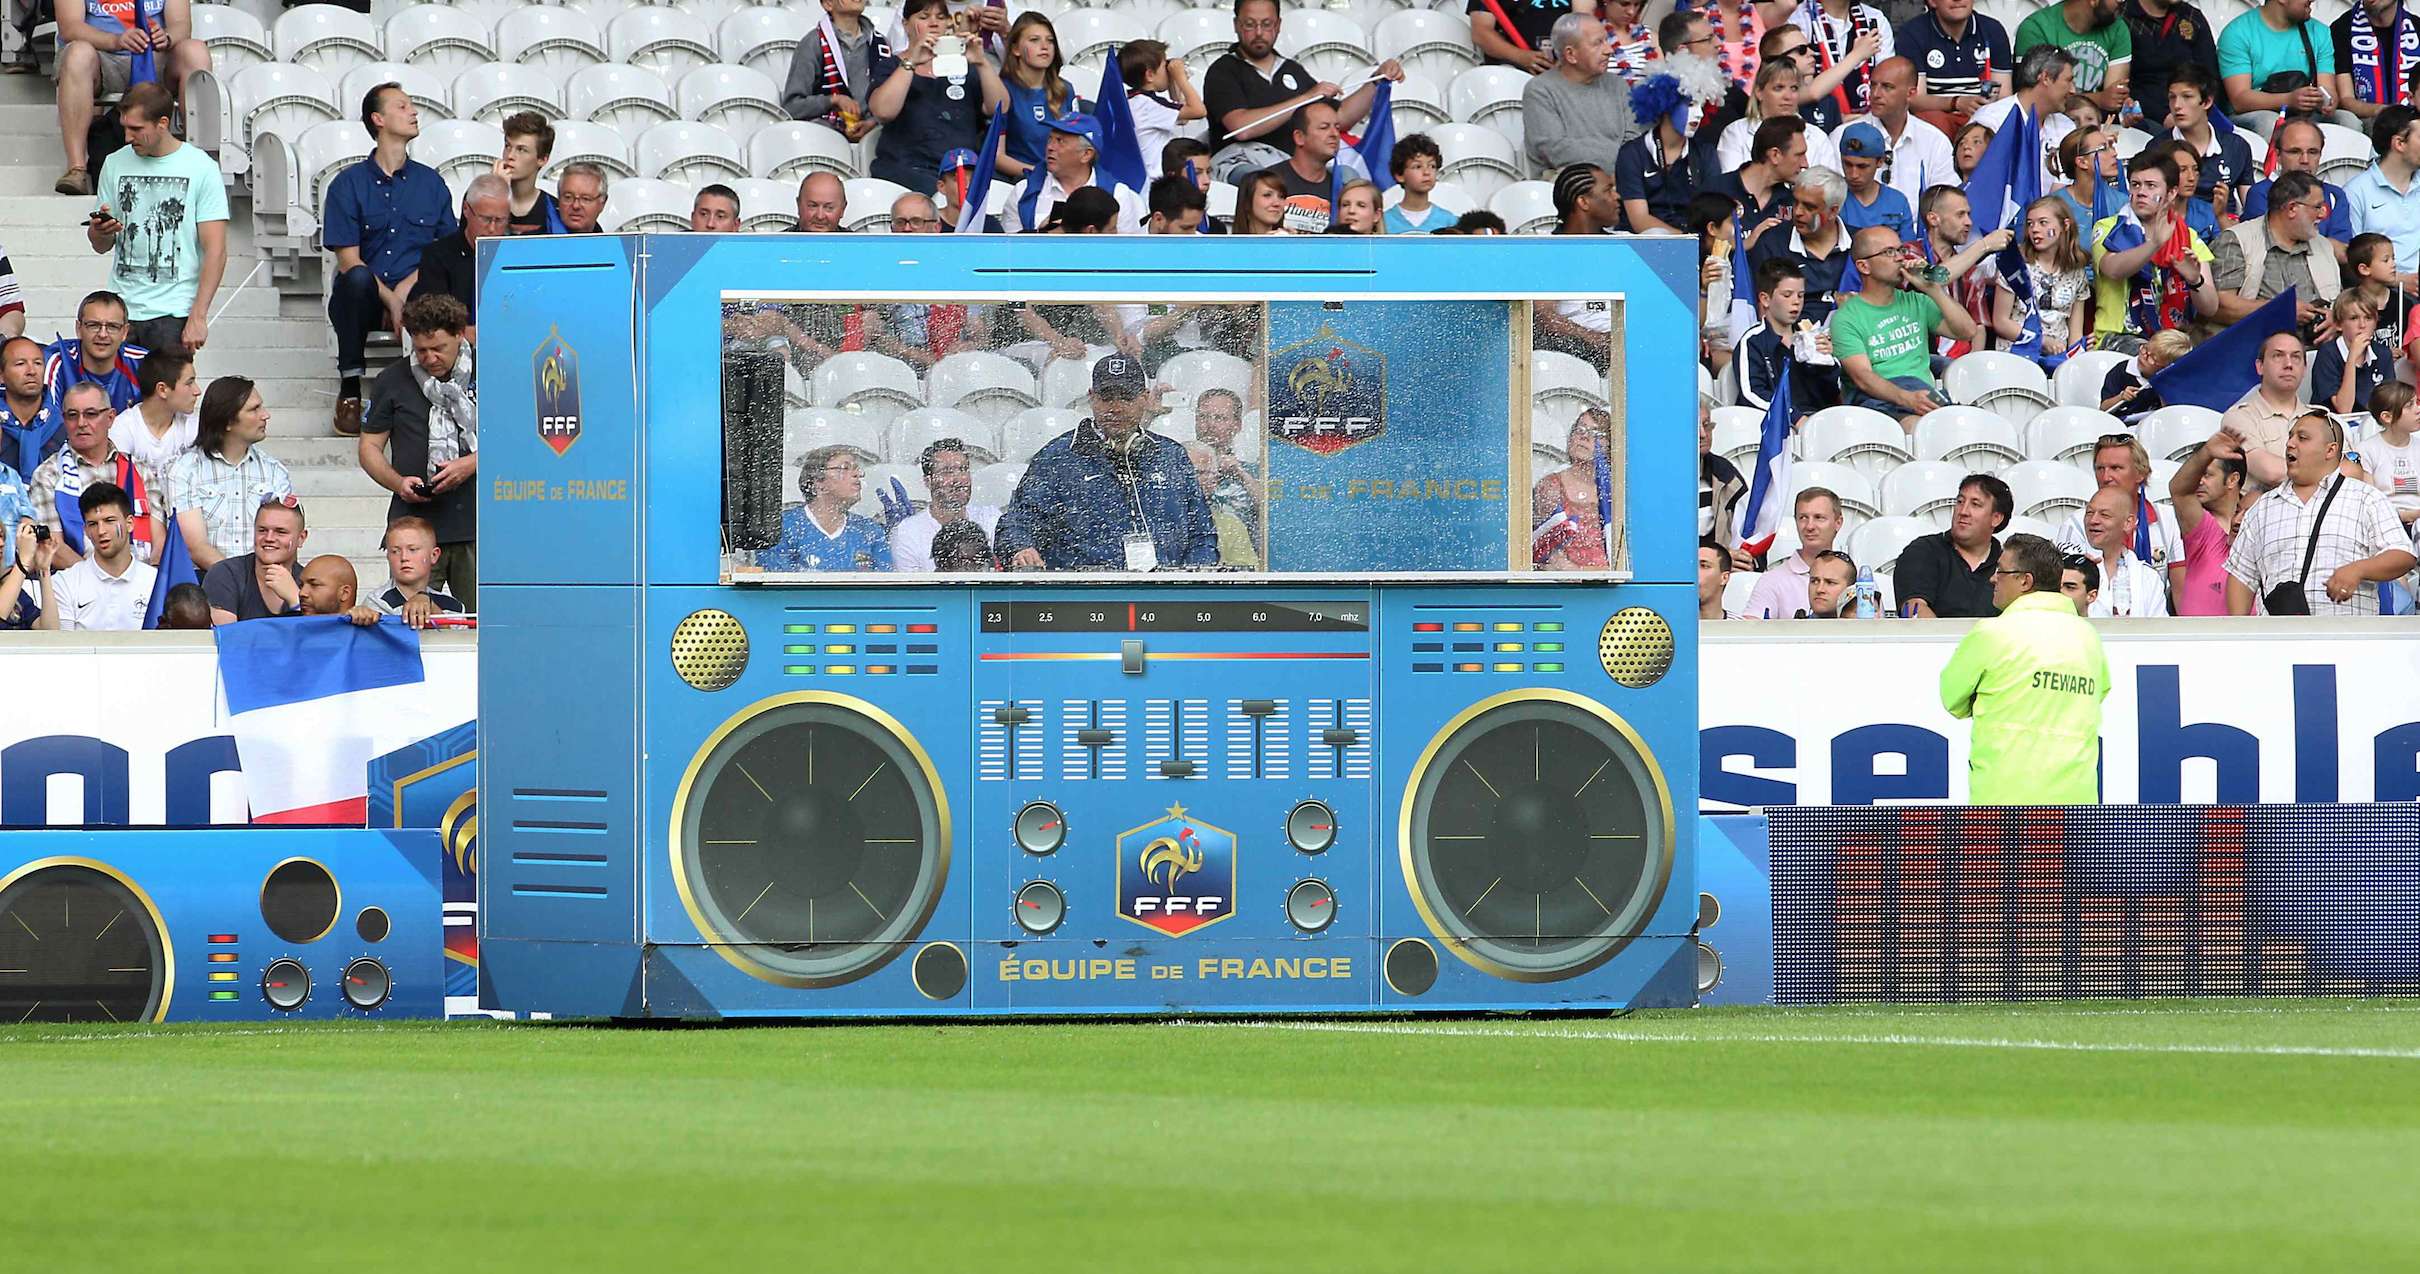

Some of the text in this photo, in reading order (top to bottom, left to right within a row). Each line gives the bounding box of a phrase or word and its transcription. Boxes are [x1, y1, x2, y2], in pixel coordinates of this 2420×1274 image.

[88, 1, 164, 15] FAÇONNBLE
[119, 182, 186, 194] BRAZIL
[1872, 335, 1923, 360] FOOTBALL
[542, 416, 577, 435] FFF
[1282, 416, 1372, 435] FFF
[494, 474, 547, 501] ÉQUIPE
[567, 479, 627, 501] FRANCE
[1349, 479, 1505, 501] FRANCE
[1340, 612, 1359, 623] mhz
[2032, 671, 2095, 696] STEWARD
[1133, 896, 1223, 916] FFF
[999, 953, 1136, 982] ÉQUIPE
[1199, 958, 1353, 980] FRANCE
